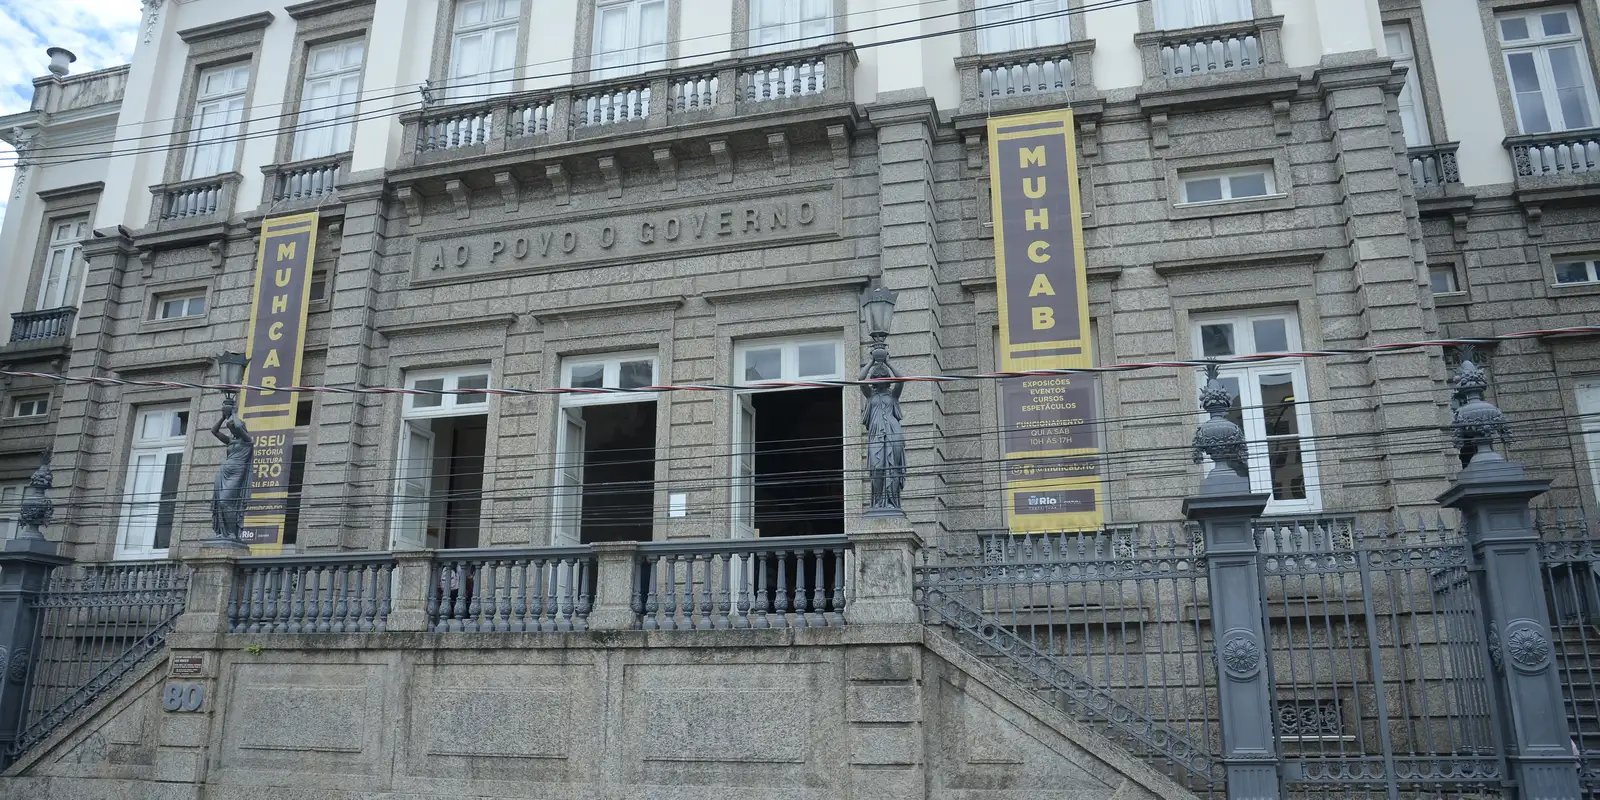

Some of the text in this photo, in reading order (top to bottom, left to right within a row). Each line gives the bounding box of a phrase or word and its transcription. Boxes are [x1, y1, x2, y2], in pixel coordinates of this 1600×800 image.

[431, 202, 815, 271] AO POVO O GOVERNO
[1018, 145, 1056, 330] MUHCAB
[259, 241, 297, 396] MUHCAB
[1022, 378, 1071, 388] EXPOSIÇÕES
[1030, 387, 1066, 395] EVENTOS
[1033, 395, 1064, 403] CURSOS
[1021, 402, 1077, 412] ESPETÁCULOS
[1016, 418, 1084, 428] FUNCIONAMENTO
[251, 434, 285, 447] USEU
[253, 448, 283, 456] ISTÓRIA
[1040, 496, 1057, 505] Rio
[163, 684, 204, 711] 80
